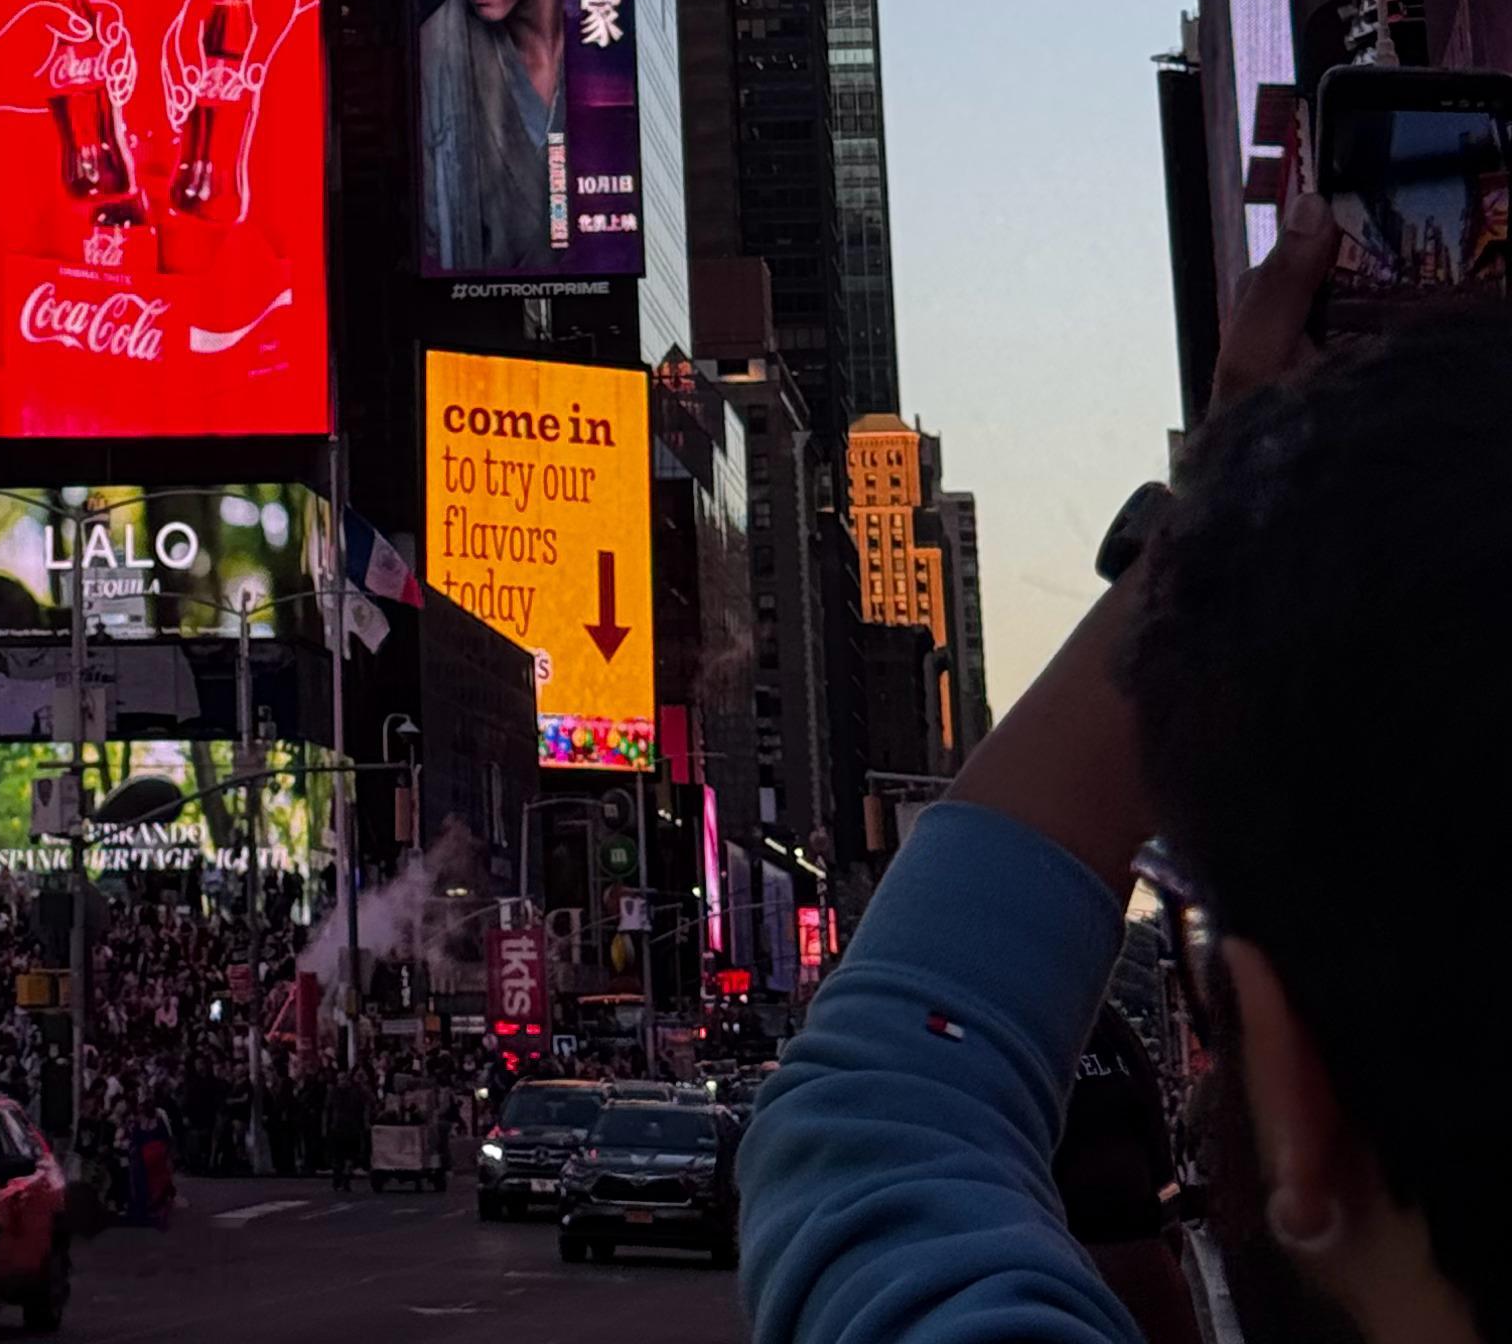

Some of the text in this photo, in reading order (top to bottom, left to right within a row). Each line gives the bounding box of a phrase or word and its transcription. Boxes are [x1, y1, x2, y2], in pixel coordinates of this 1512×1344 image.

[576, 175, 634, 195] 10月1日
[20, 281, 171, 361] Coca-Cola
[451, 280, 609, 300] #OUTFRONTPRIME
[442, 402, 617, 448] come in
[442, 445, 596, 513] to try our
[45, 522, 199, 570] LALO
[442, 504, 559, 567] flavors
[442, 568, 536, 638] today
[500, 935, 538, 1017] tkts
